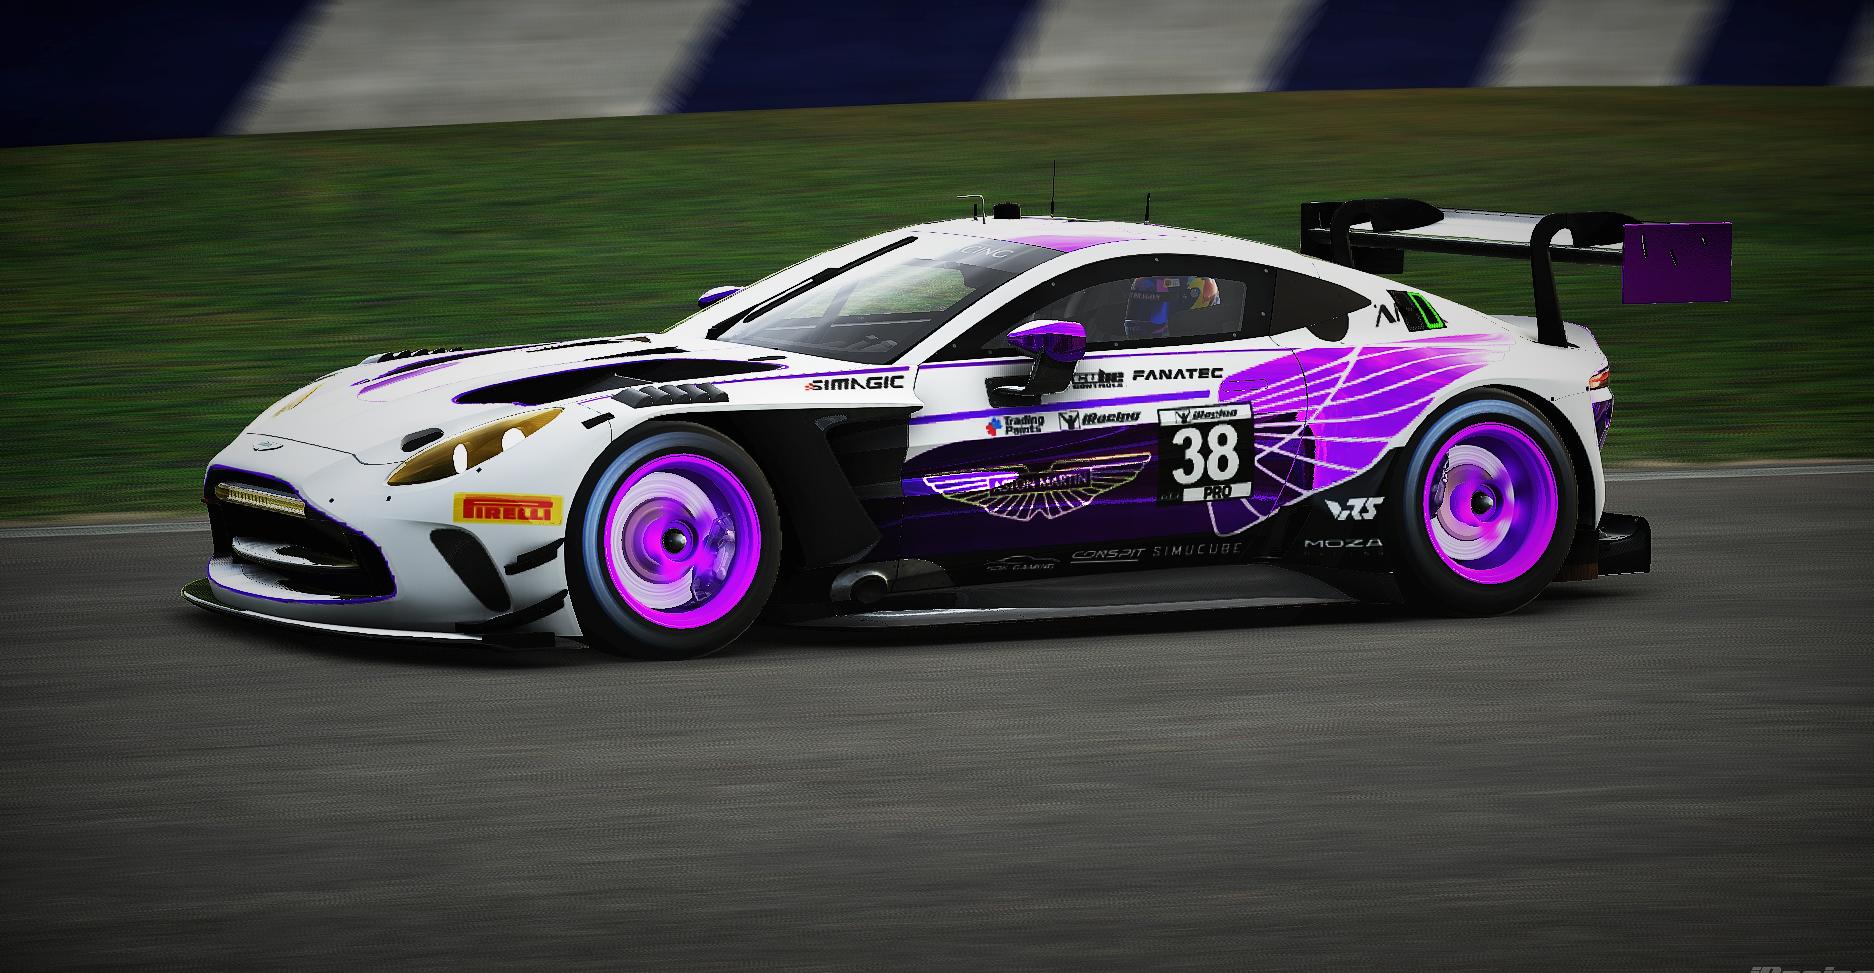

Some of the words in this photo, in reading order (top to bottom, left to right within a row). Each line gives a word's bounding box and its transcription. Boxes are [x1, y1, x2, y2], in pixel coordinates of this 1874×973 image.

[1132, 367, 1224, 381] FANATEC
[812, 375, 905, 391] SIMAGIC
[1003, 414, 1045, 427] Trading
[1081, 410, 1142, 426] iRacing
[1172, 423, 1240, 485] 38
[1203, 484, 1233, 500] PRO
[462, 497, 553, 521] PIRELLI
[1324, 496, 1385, 521] VRS
[1152, 542, 1242, 558] SIMUCUBE
[1304, 538, 1384, 548] MOZA
[1071, 547, 1147, 560] CONSPIT
